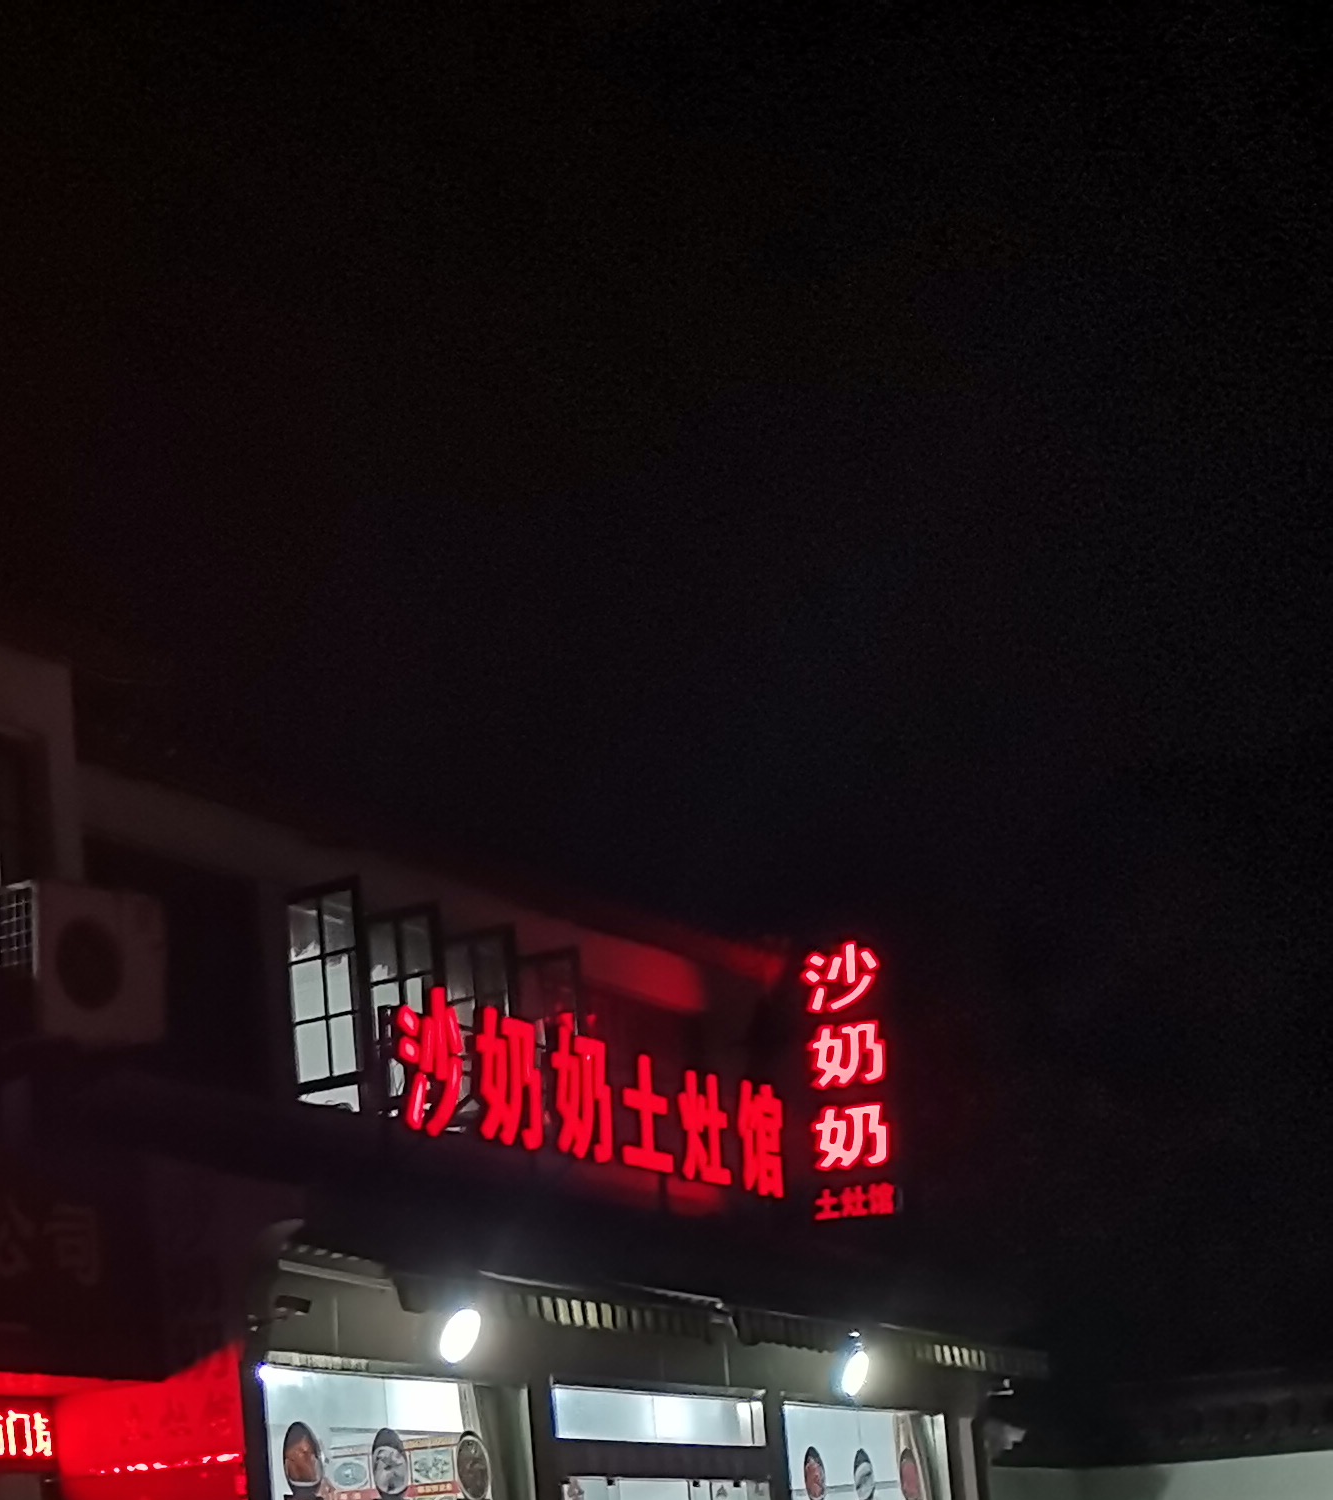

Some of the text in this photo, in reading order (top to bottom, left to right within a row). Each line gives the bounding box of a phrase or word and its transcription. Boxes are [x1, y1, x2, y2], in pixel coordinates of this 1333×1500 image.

[394, 984, 786, 1201] 沙奶奶土灶馆
[800, 939, 894, 1172] 沙奶奶
[813, 1182, 896, 1222] 土灶馆
